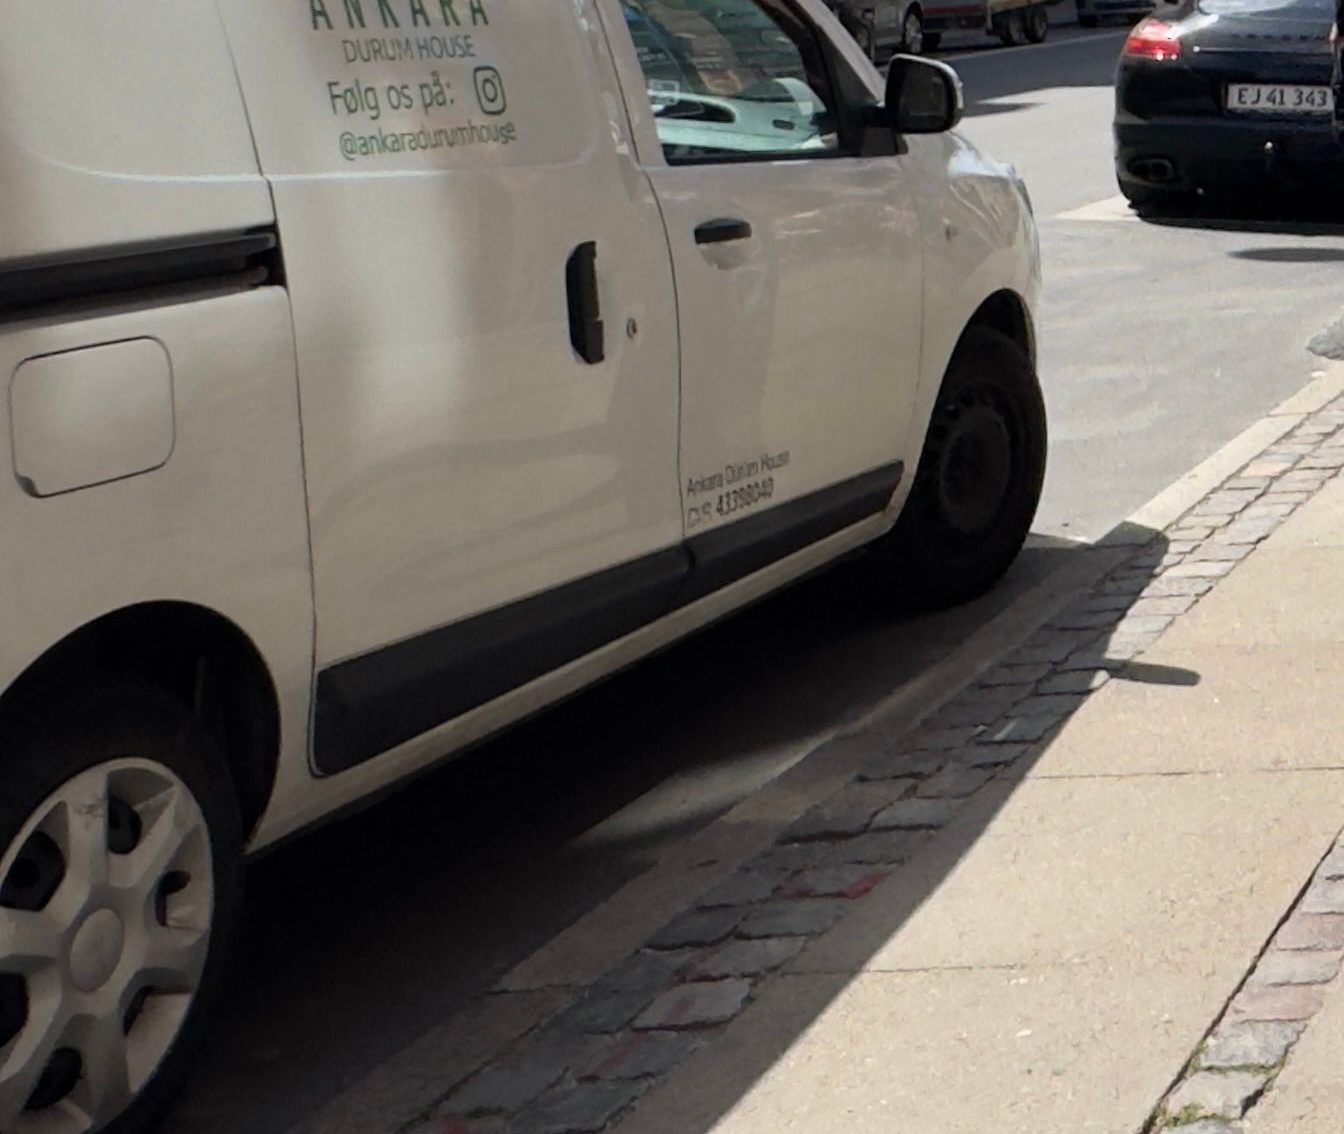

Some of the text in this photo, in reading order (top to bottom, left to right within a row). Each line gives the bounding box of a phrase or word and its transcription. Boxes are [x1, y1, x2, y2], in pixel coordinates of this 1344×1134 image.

[418, 35, 477, 59] HOUSE
[327, 71, 455, 120] Følg os på:
[1238, 87, 1327, 107] EJ 41 343
